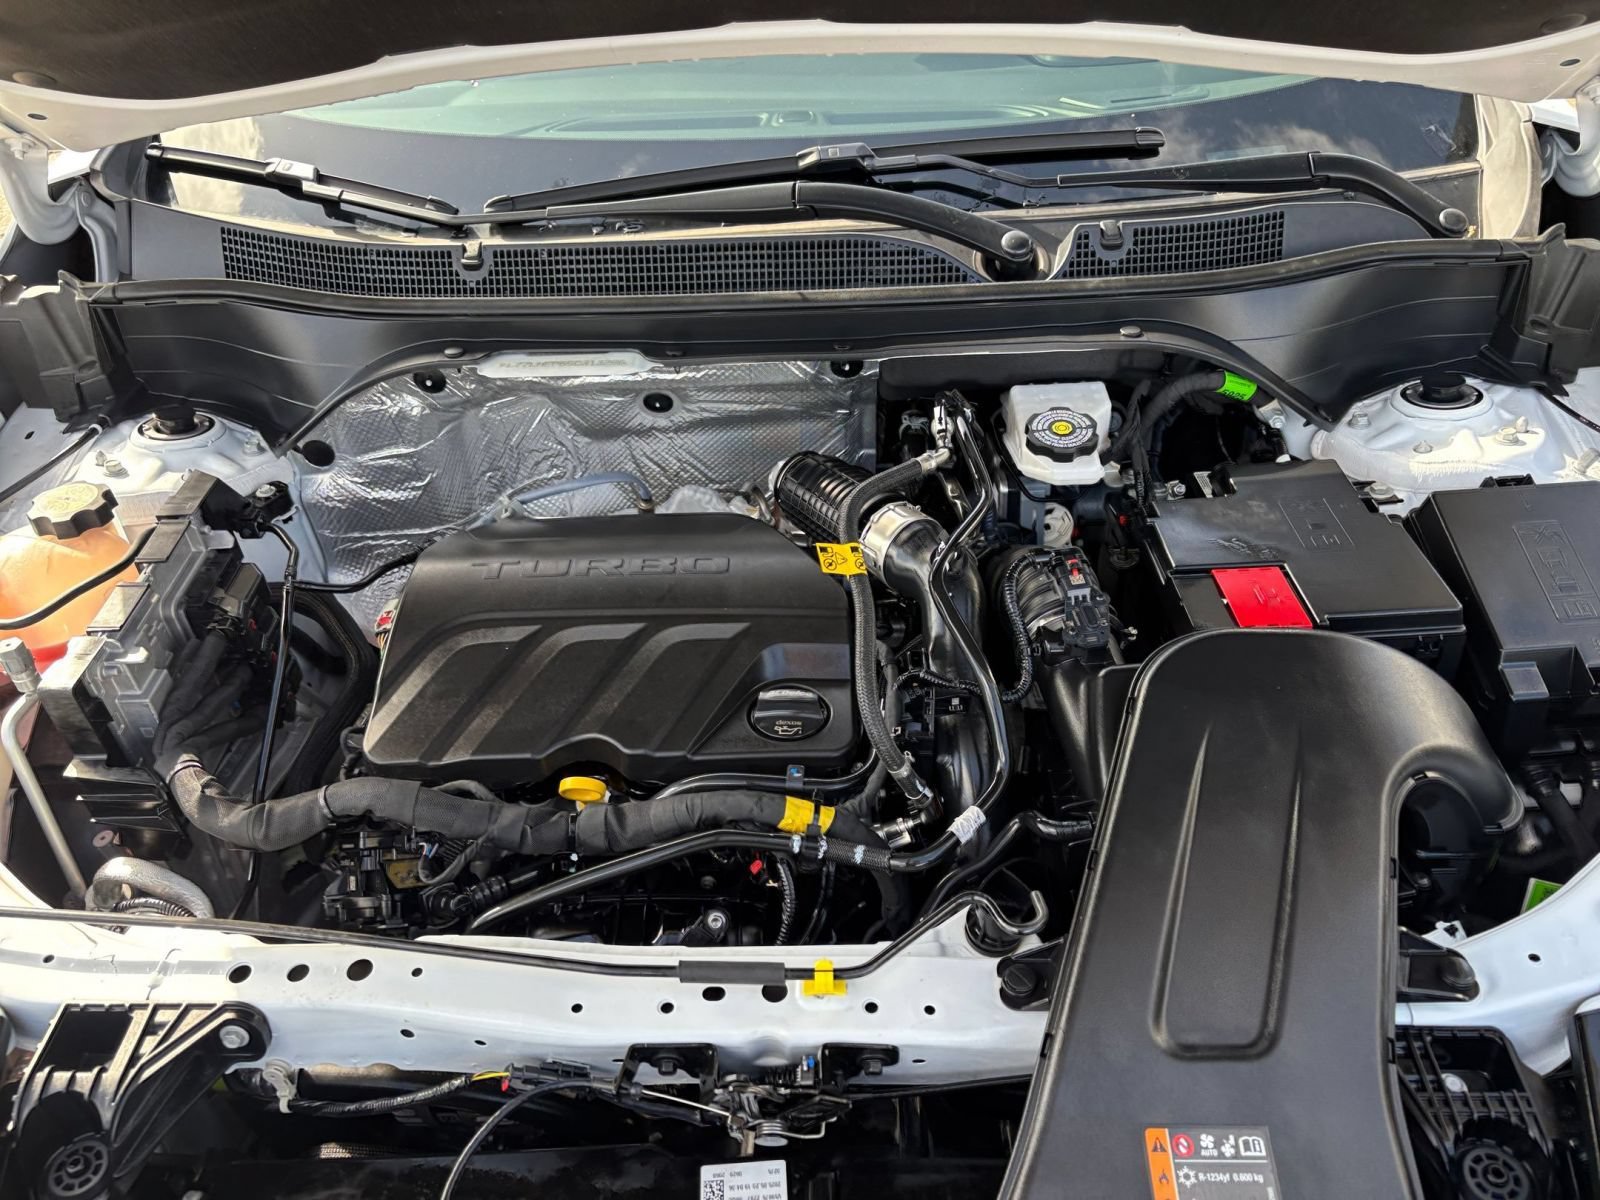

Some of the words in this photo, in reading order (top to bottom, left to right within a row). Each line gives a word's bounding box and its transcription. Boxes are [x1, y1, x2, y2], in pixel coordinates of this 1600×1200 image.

[472, 557, 730, 579] TURBO
[1198, 1172, 1230, 1183] R-1234yf
[1254, 1172, 1264, 1184] kg
